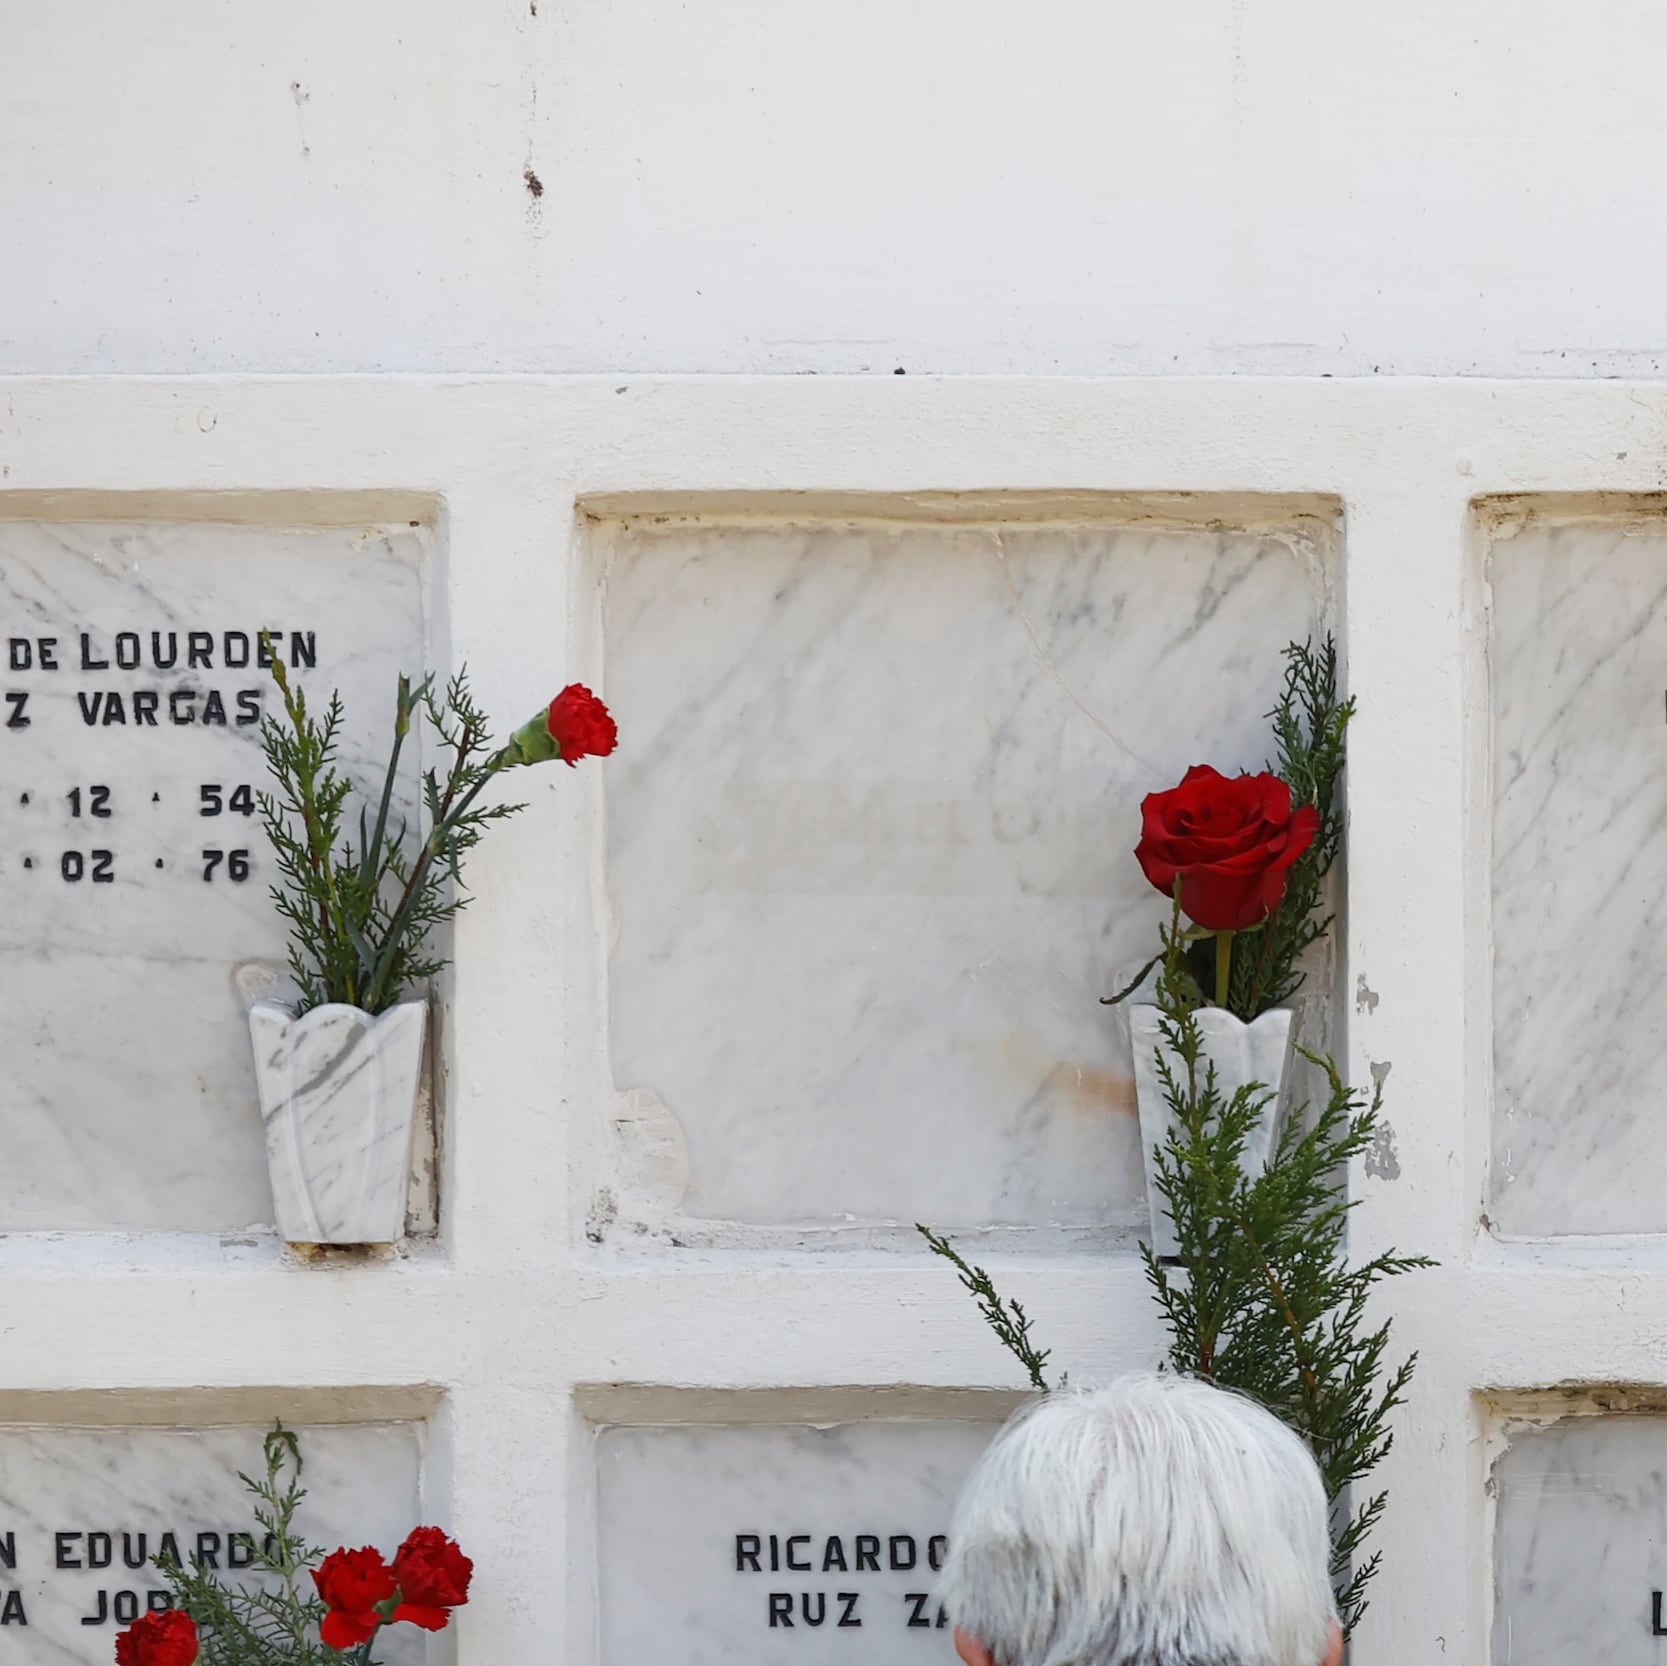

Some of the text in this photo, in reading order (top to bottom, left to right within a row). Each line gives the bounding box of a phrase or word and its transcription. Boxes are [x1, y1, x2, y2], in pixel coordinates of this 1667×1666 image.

[9, 630, 317, 671] DE LOURDEN
[76, 689, 262, 726] VARGAS
[67, 784, 256, 818] 12 54
[61, 849, 250, 883] 02 76
[768, 1592, 863, 1628] RUZ
